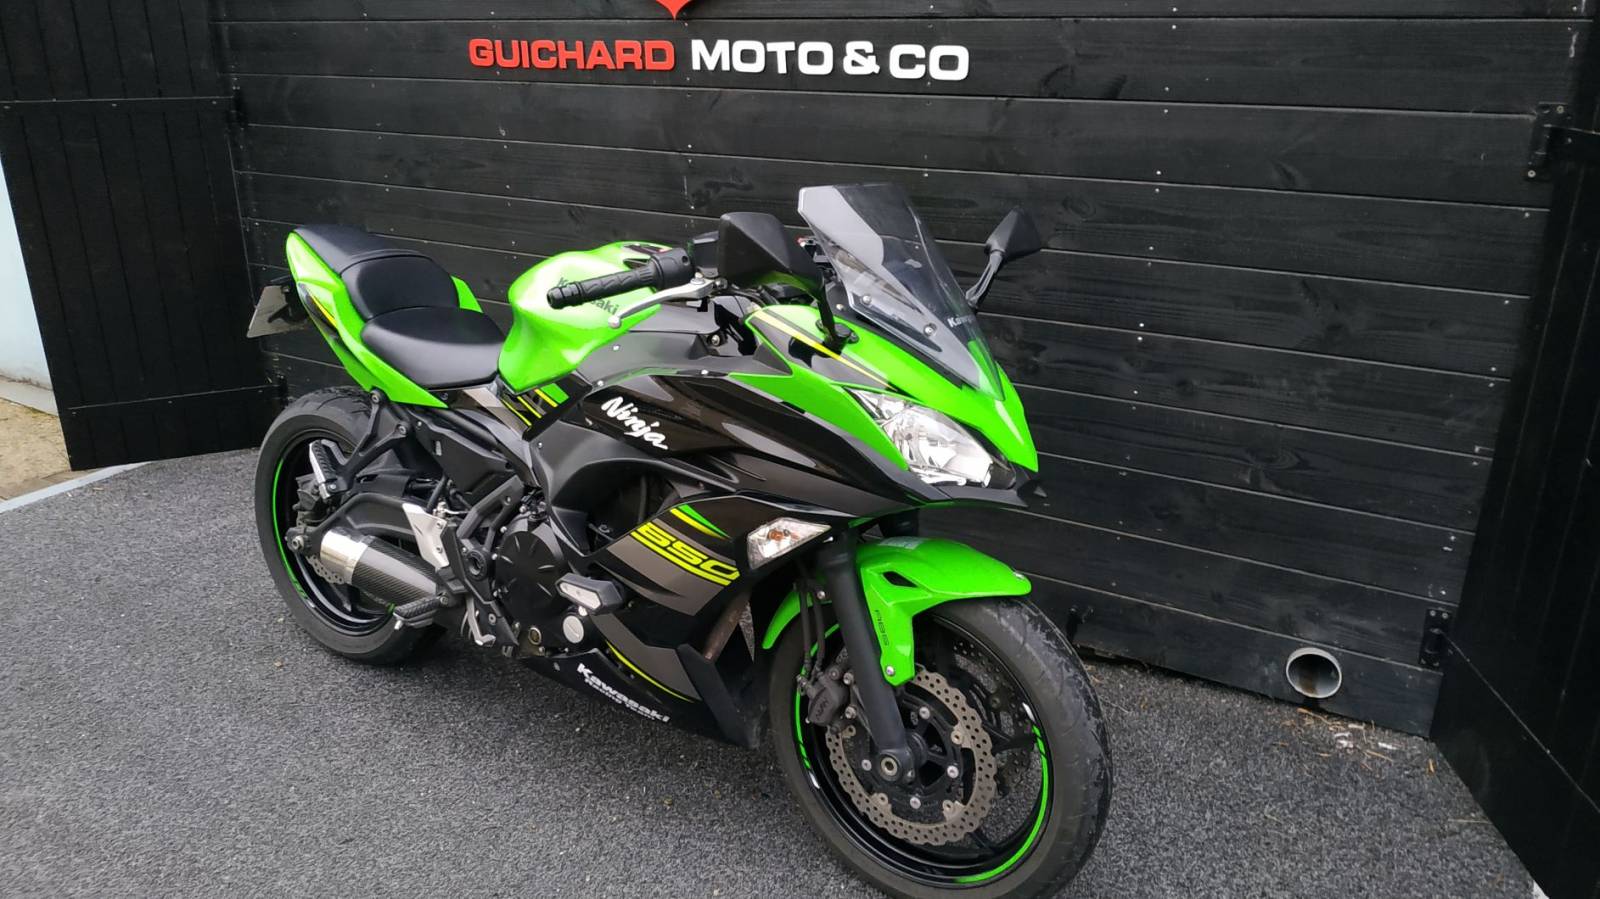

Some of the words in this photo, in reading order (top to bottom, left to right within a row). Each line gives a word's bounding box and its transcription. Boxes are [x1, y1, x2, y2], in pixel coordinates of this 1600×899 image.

[468, 39, 675, 71] GUICHARD
[691, 39, 834, 75] MOTO
[889, 45, 970, 81] CO
[601, 396, 669, 450] Ninja
[632, 521, 741, 580] 650
[576, 662, 670, 722] Kawasaki
